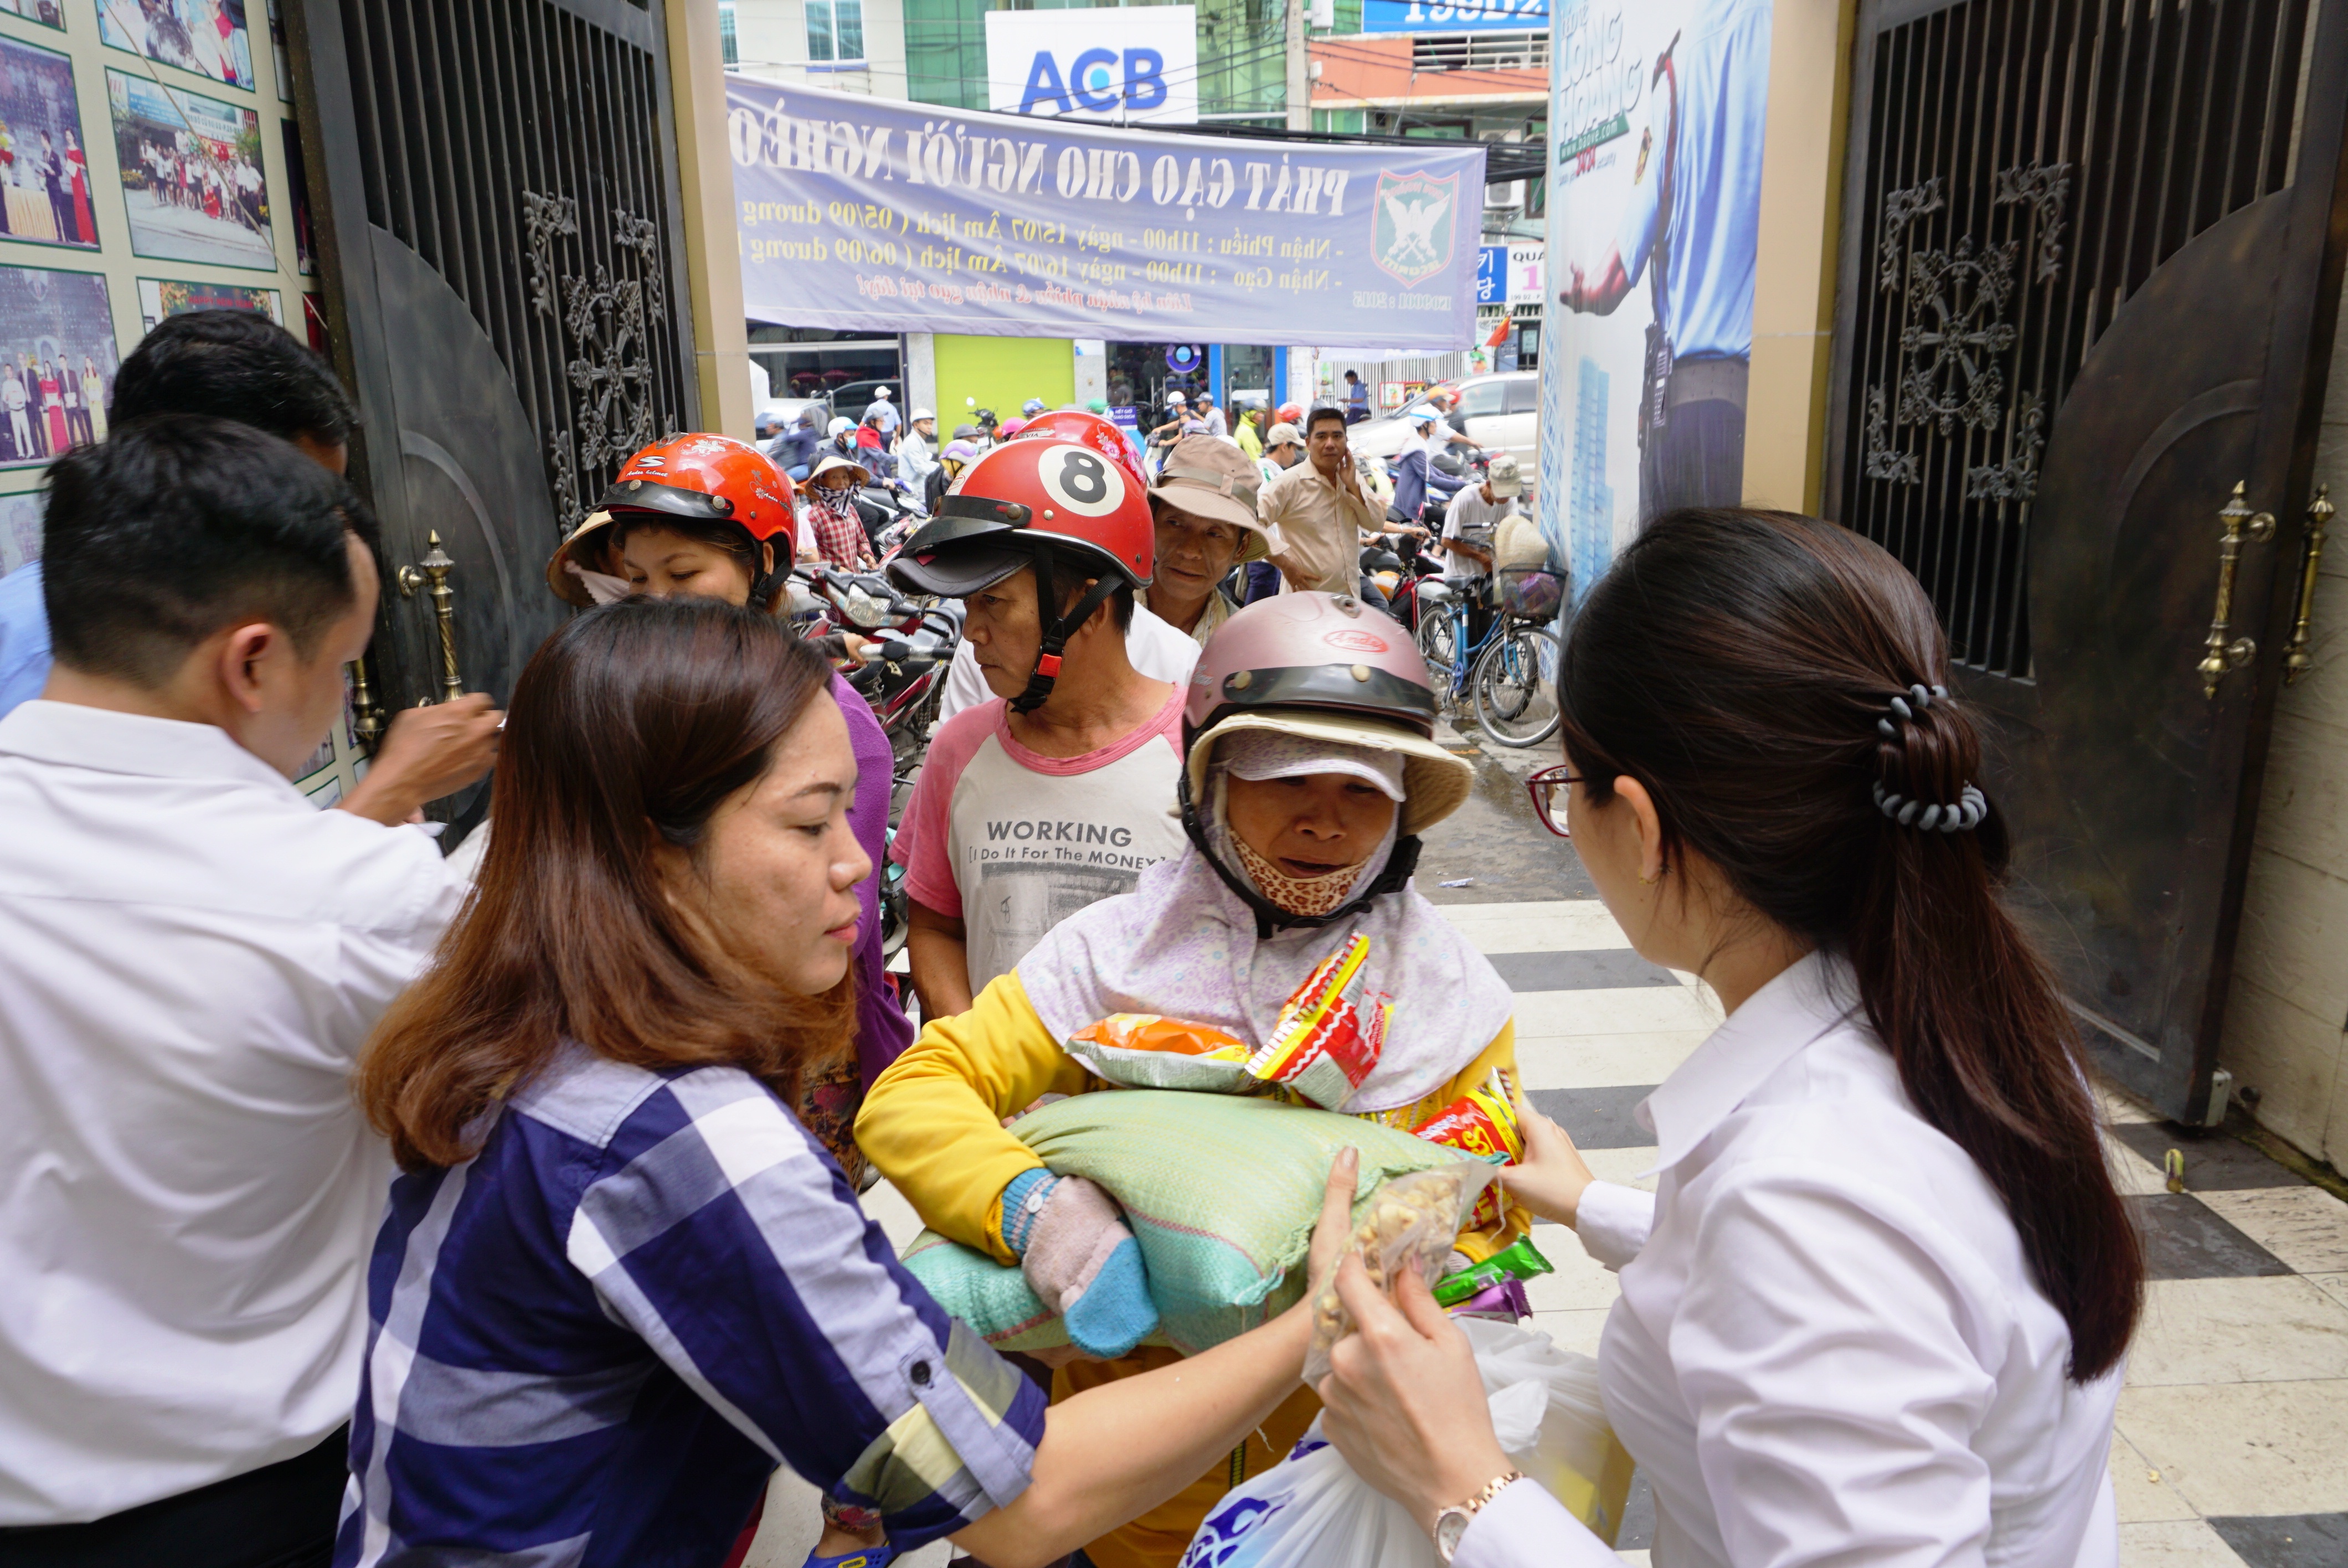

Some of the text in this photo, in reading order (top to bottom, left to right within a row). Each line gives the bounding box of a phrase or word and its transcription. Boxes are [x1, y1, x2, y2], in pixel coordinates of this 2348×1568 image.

[1018, 47, 1167, 112] ACB
[1059, 451, 1107, 504] 8
[987, 821, 1132, 847] WORKING
[981, 848, 1000, 860] Do
[1005, 847, 1016, 859] It
[1022, 847, 1049, 859] For
[1055, 847, 1083, 861] The
